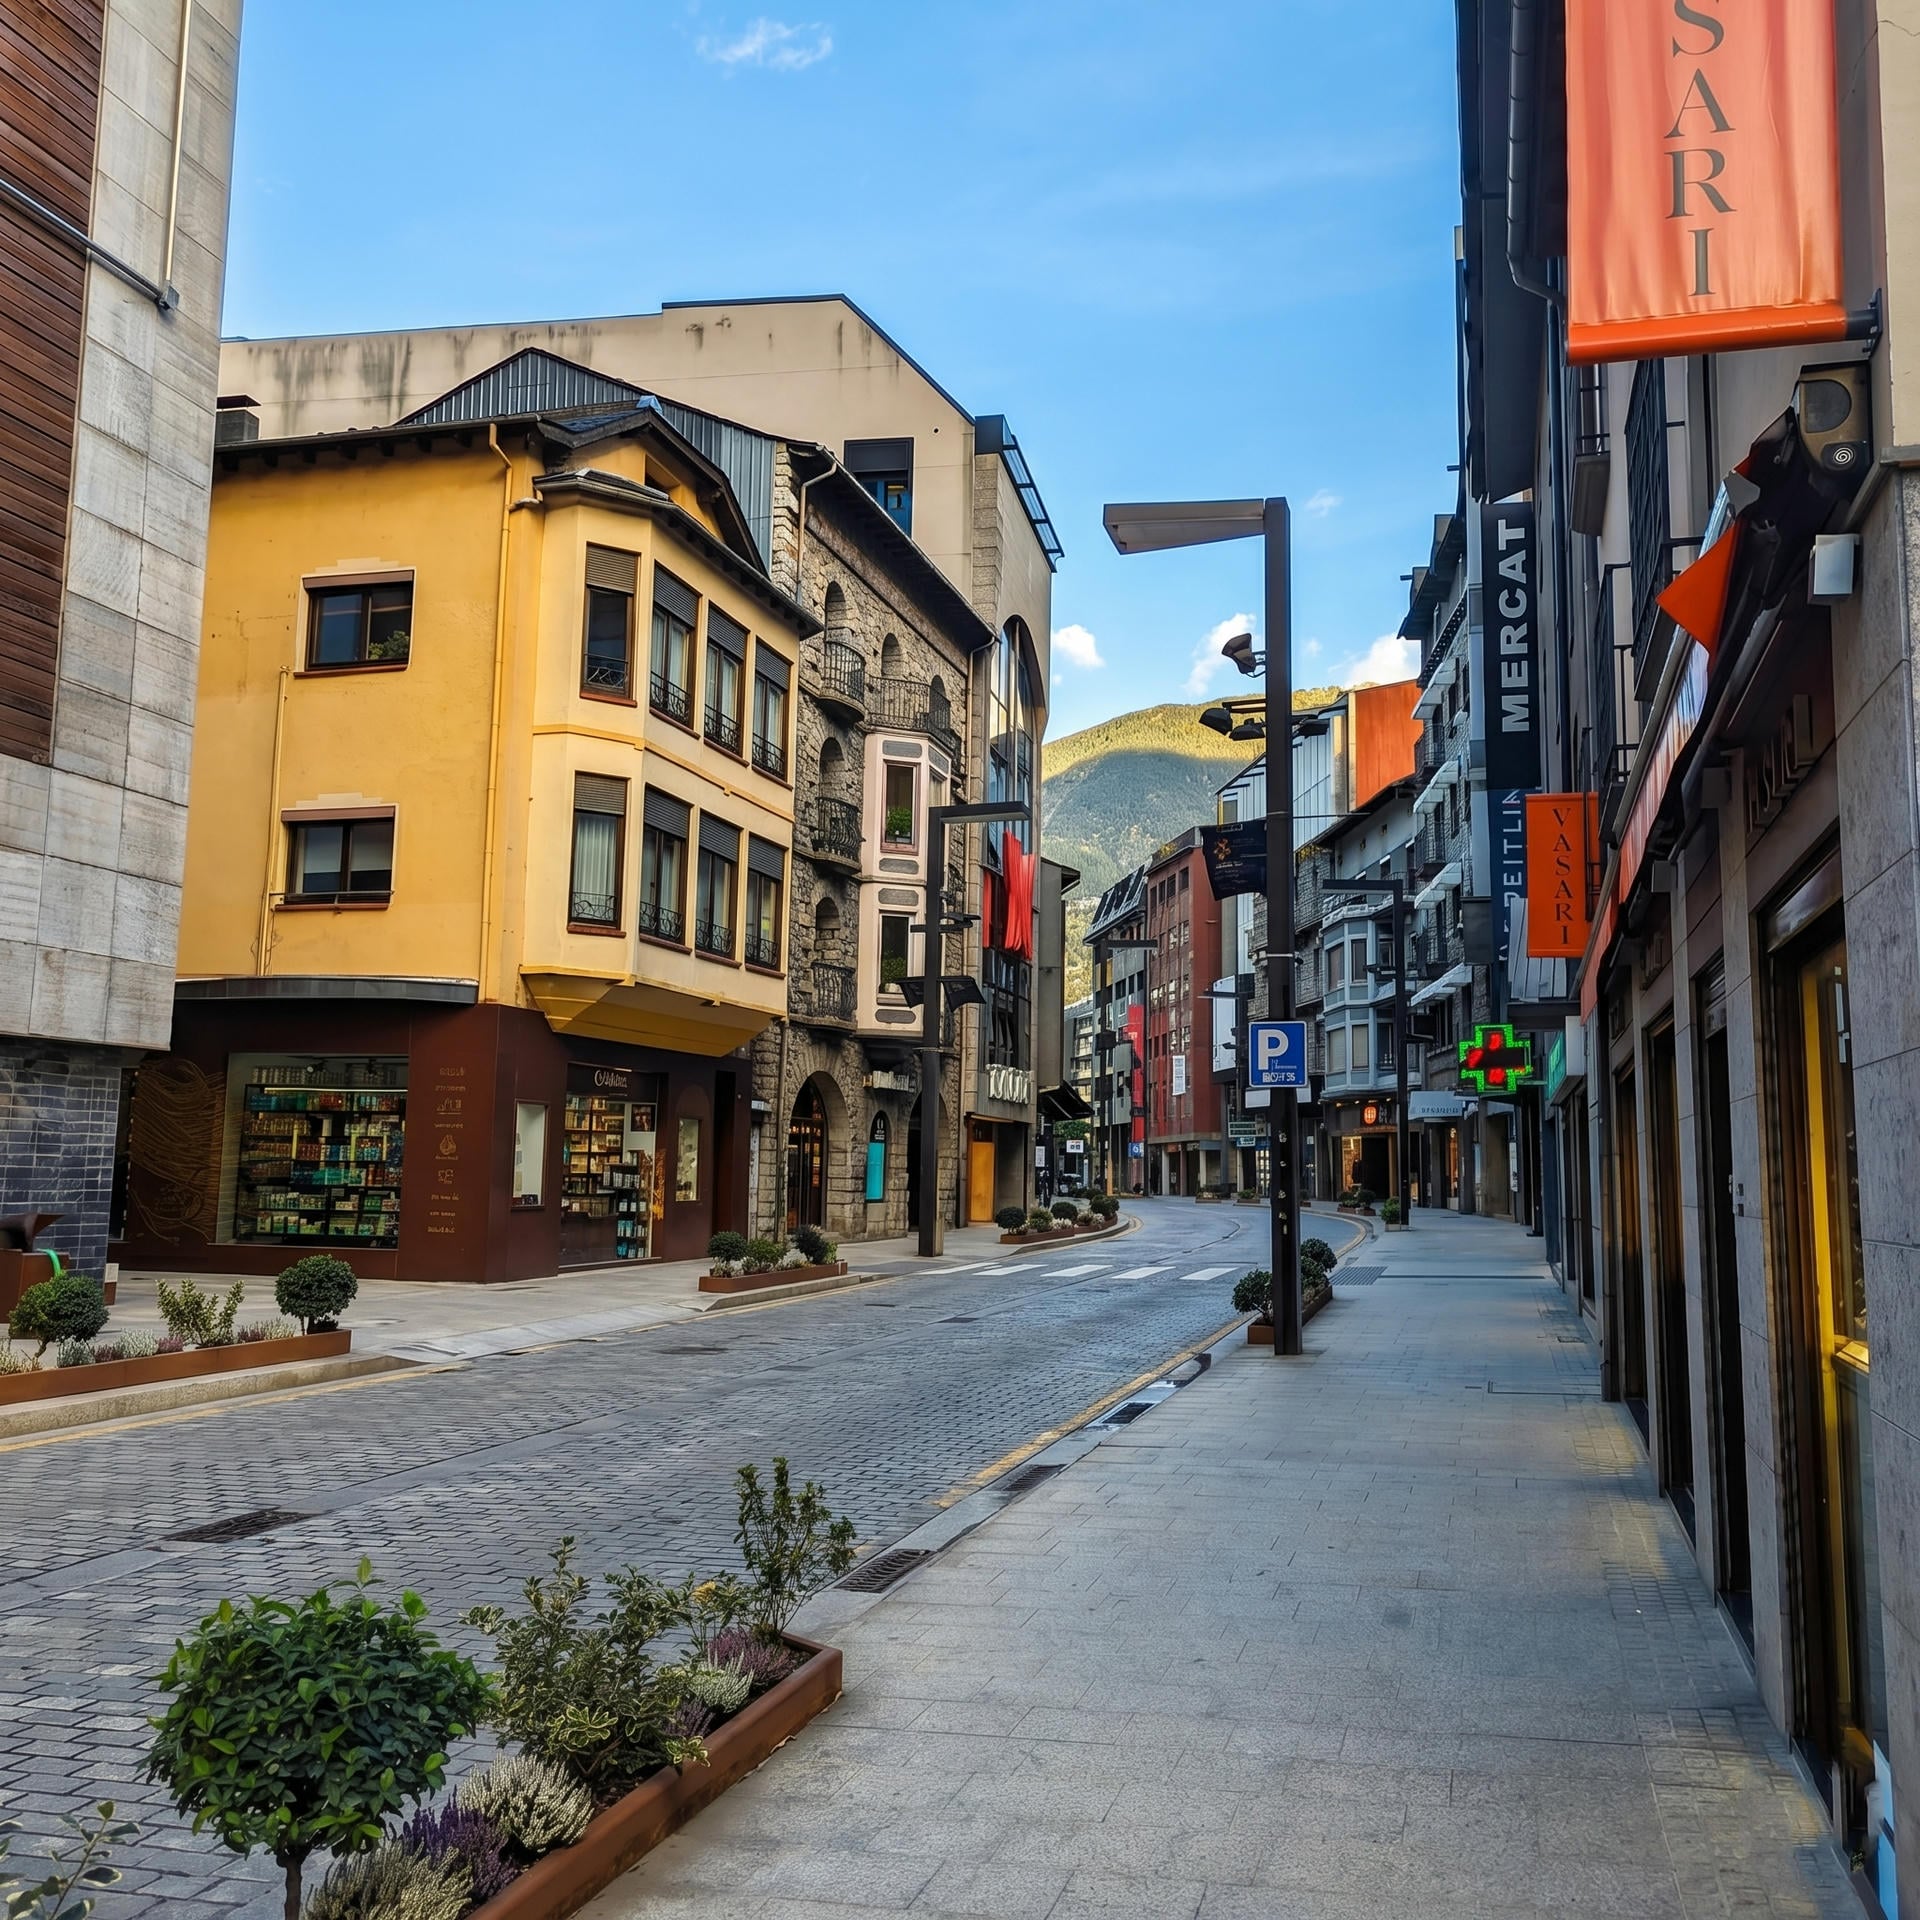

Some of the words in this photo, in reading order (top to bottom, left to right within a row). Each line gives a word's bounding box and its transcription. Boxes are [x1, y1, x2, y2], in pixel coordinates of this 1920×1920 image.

[1498, 519, 1530, 733] MERCAT
[1552, 807, 1574, 946] VASARI
[1257, 1029, 1289, 1071] P
